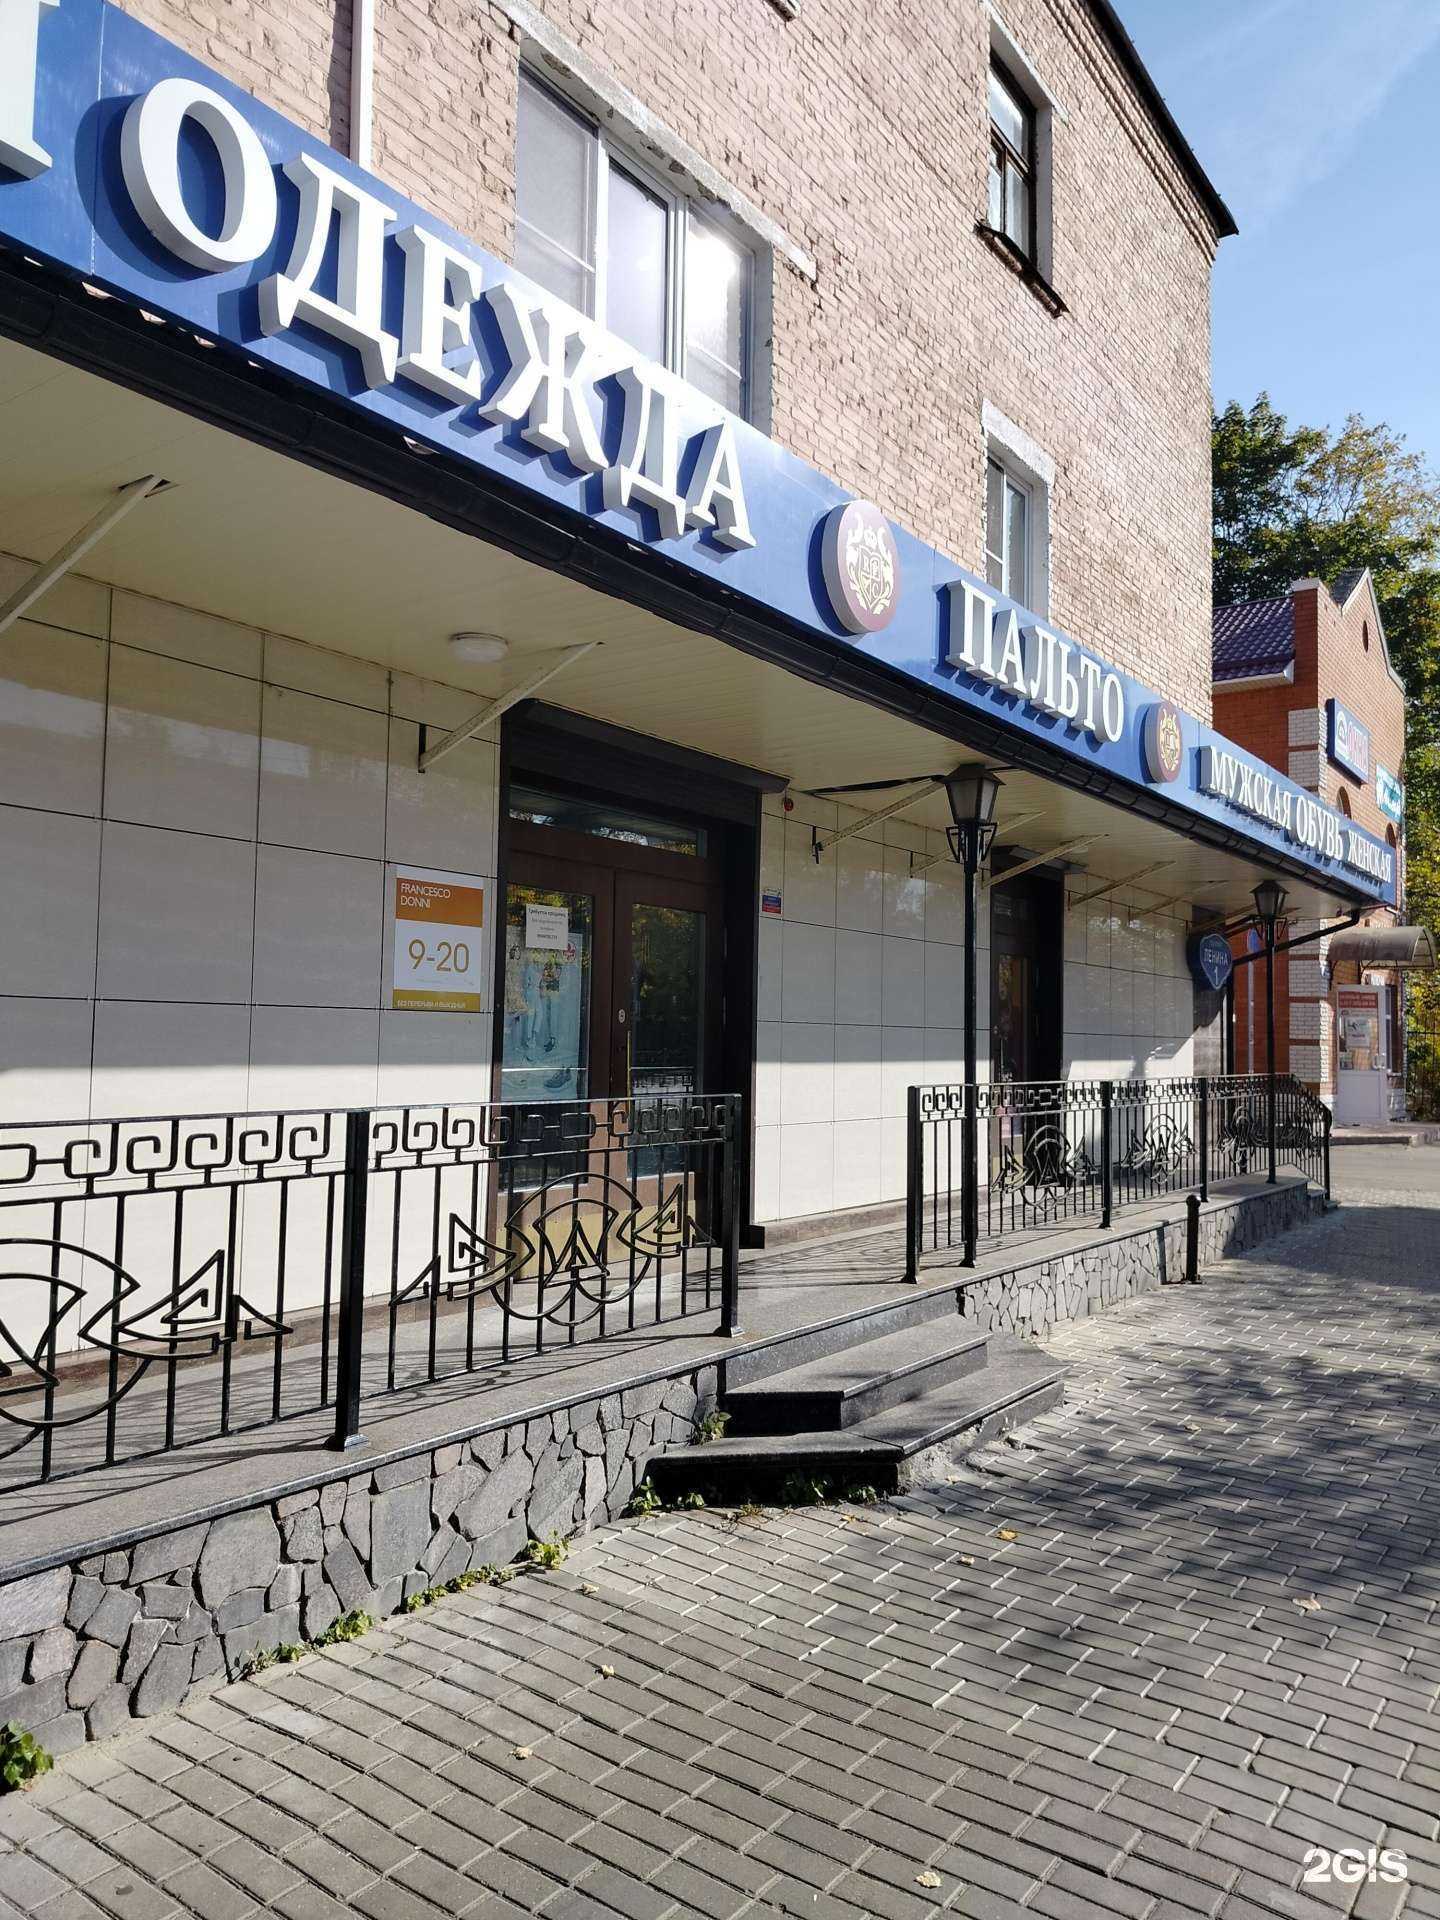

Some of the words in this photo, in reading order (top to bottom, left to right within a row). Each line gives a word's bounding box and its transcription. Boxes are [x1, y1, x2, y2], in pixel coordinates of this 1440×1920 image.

[122, 78, 757, 550] ОДЕЖДА
[952, 580, 1124, 742] ПАЛЬТО
[1209, 745, 1291, 830] МУЖСКАЯ
[1295, 794, 1344, 861] ОБУВЬ
[1347, 829, 1391, 883] ЖЕНСКАЯ
[400, 882, 451, 899] FRANCESCO
[400, 895, 431, 908] DONNI
[408, 939, 469, 973] 9-20
[1203, 948, 1229, 966] ЛЕНИНА
